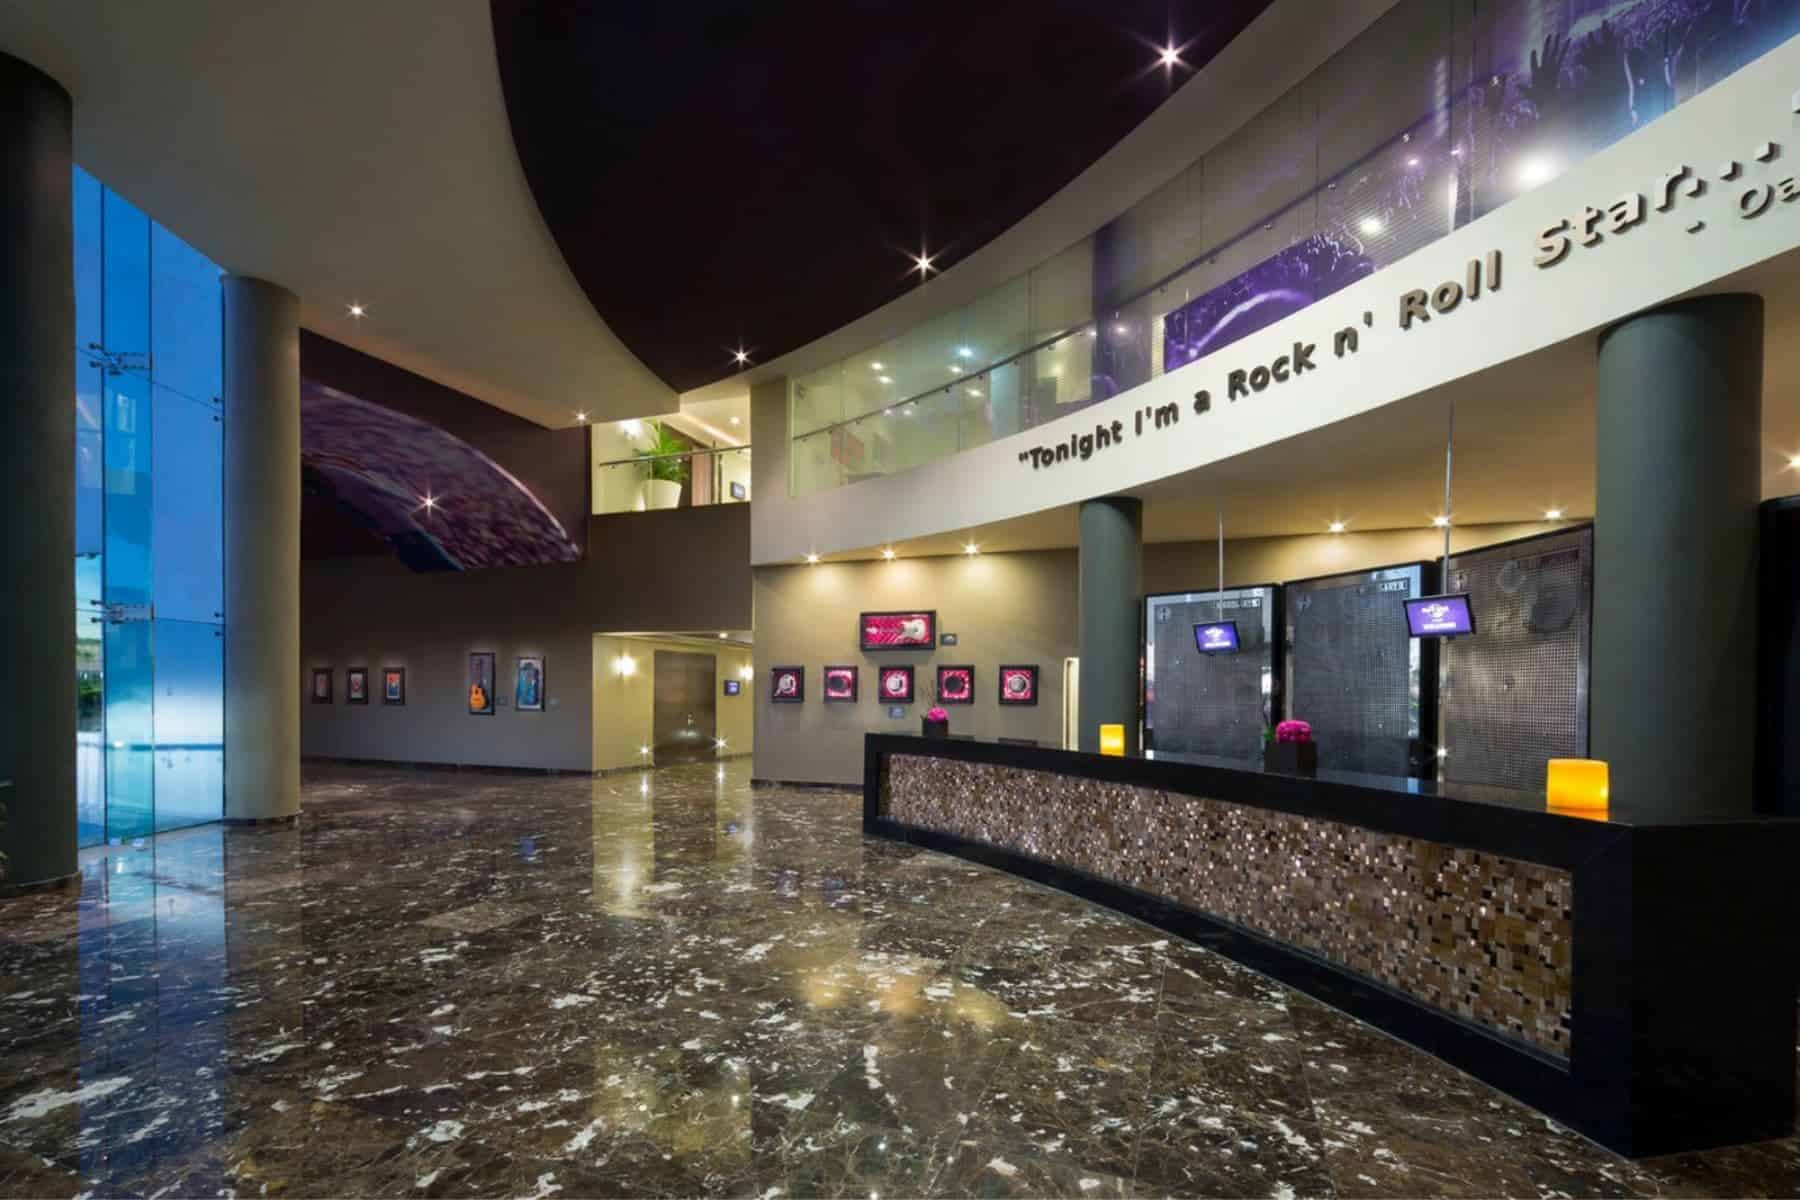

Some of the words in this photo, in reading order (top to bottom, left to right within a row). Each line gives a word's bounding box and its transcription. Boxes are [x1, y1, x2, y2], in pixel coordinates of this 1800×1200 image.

[1018, 419, 1123, 470] "Tonight
[1134, 402, 1179, 435] I'm
[1193, 389, 1211, 414] a
[1227, 341, 1316, 402] Rock
[1333, 310, 1373, 358] n'
[1399, 249, 1503, 331] Roll
[1534, 88, 1800, 269] Star...
